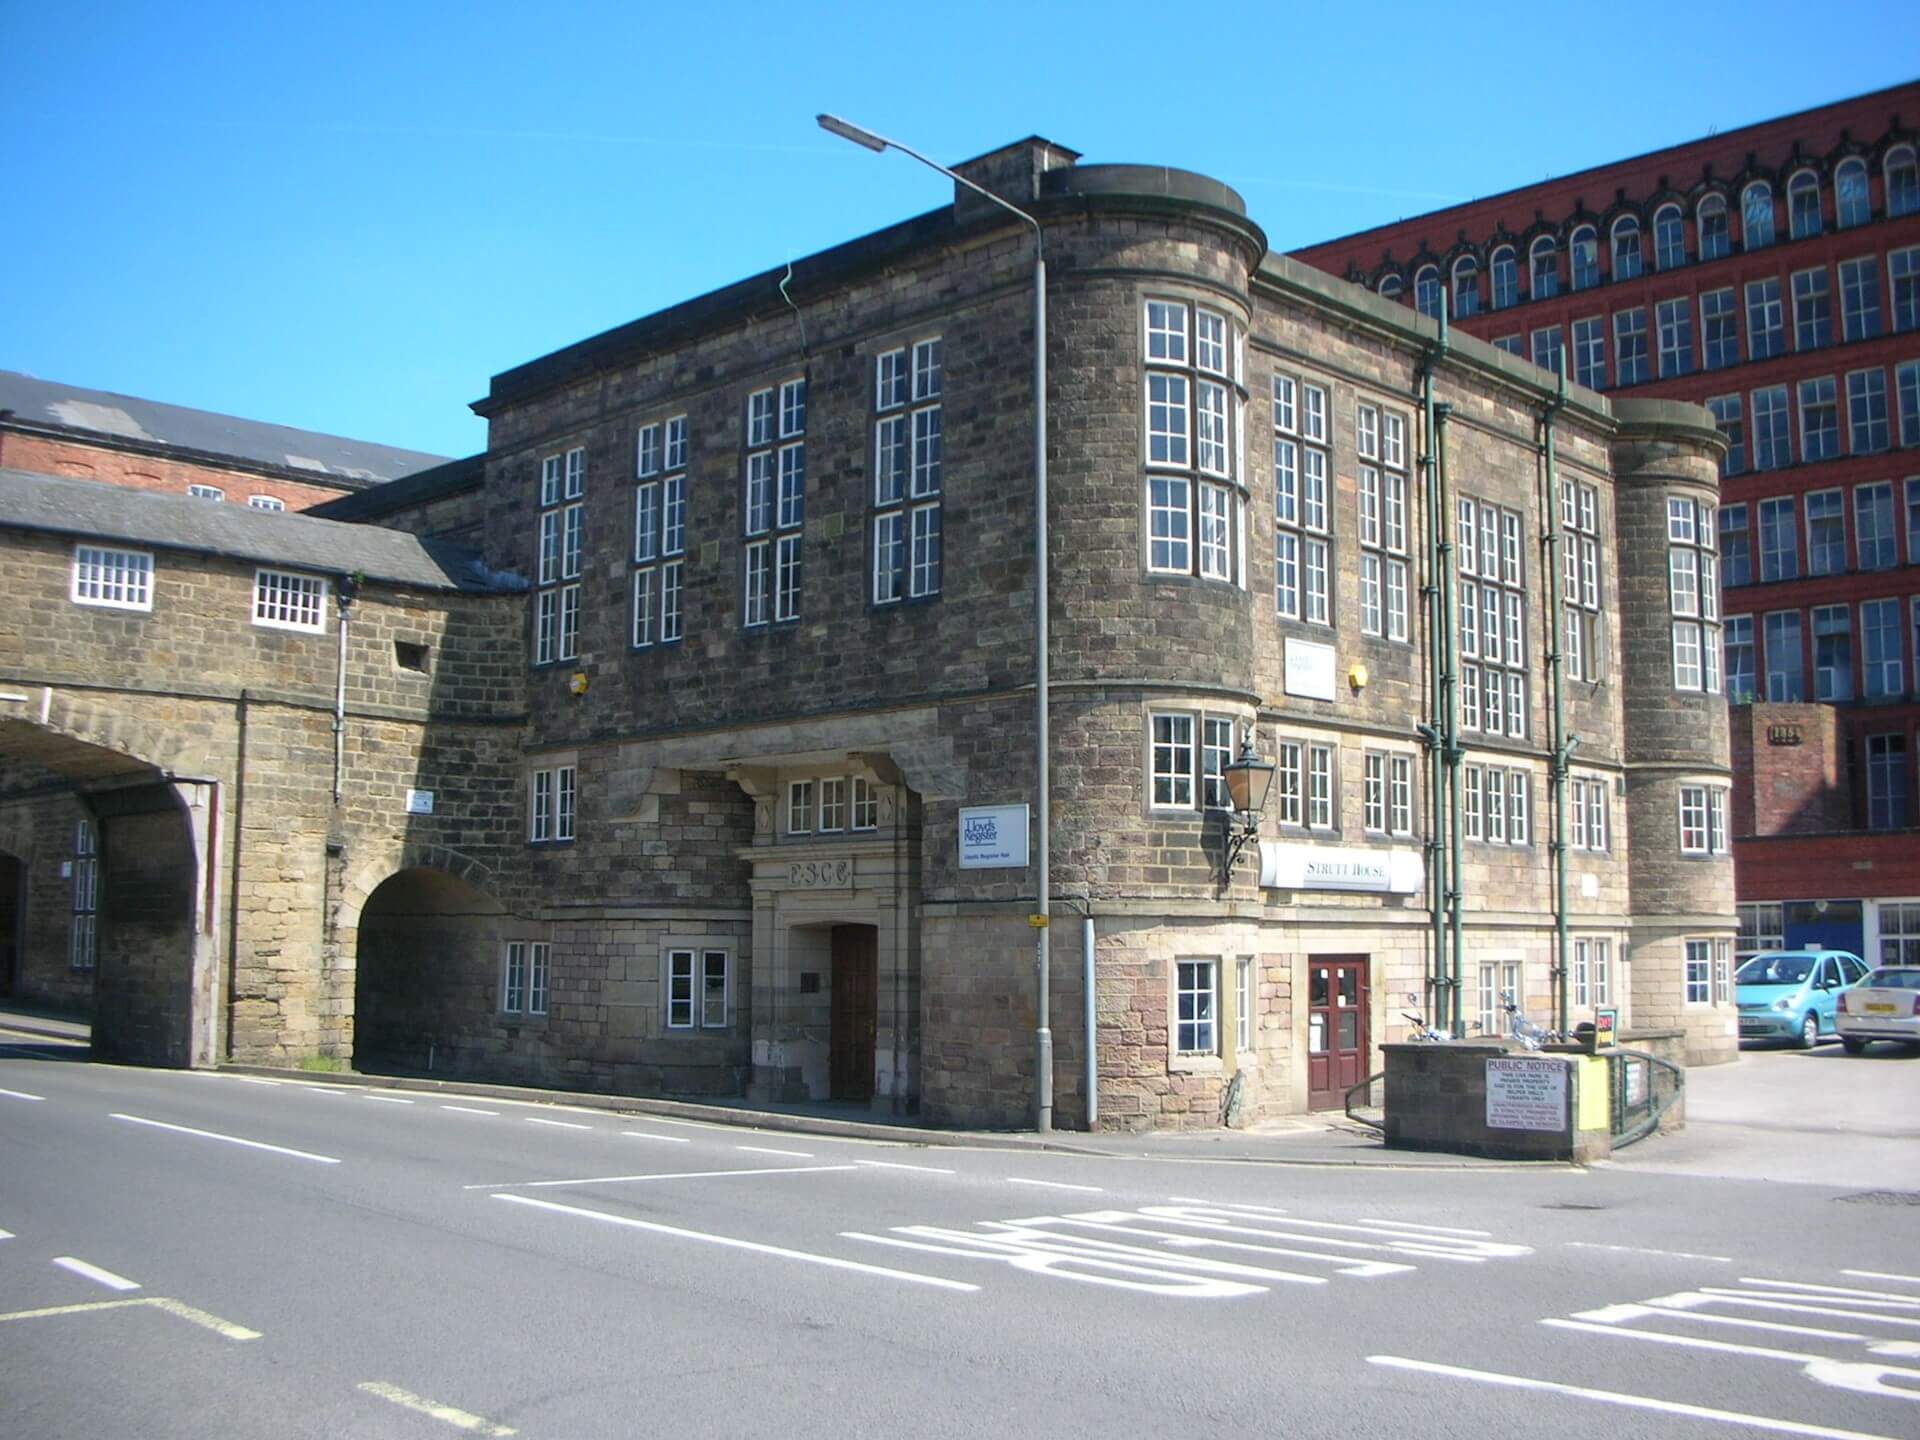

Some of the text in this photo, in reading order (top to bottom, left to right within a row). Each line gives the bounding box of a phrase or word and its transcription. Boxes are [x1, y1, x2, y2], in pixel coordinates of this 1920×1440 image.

[964, 831, 997, 844] Register
[1307, 862, 1385, 877] STRUTT HOUSE
[1488, 1060, 1563, 1072] PUBLIC NOTICE
[836, 1205, 1536, 1298] CLEAR
